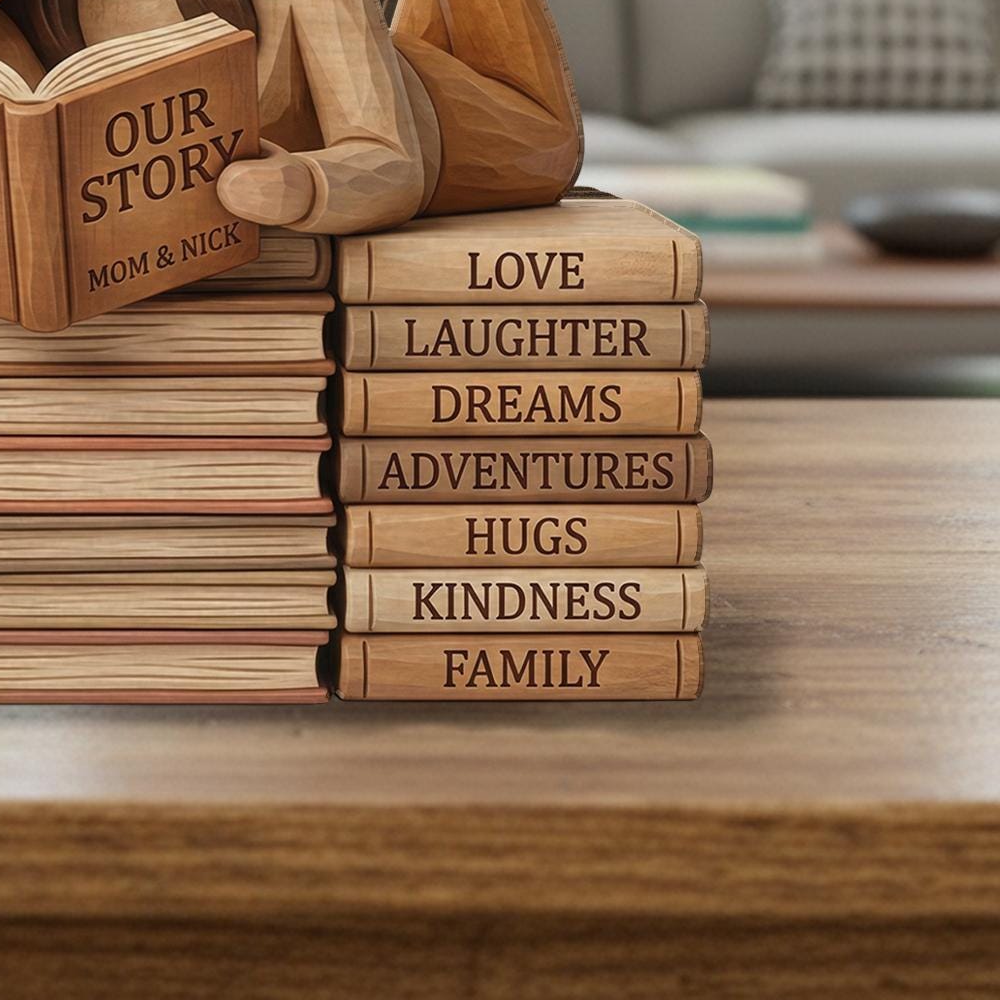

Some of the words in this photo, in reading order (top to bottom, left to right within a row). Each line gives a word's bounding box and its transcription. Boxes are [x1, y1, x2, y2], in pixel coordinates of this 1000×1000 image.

[105, 87, 215, 157] OUR
[80, 128, 244, 224] STORY
[87, 252, 150, 292] MOM
[156, 245, 175, 269] &
[180, 222, 242, 262] NICK
[467, 252, 585, 290] LOVE
[404, 318, 651, 357] LAUGHTER
[431, 385, 622, 423] DREAMS
[377, 452, 675, 490] ADVENTURES
[465, 517, 588, 555] HUGS
[412, 582, 642, 621] KINDNESS
[443, 649, 610, 688] FAMILY
